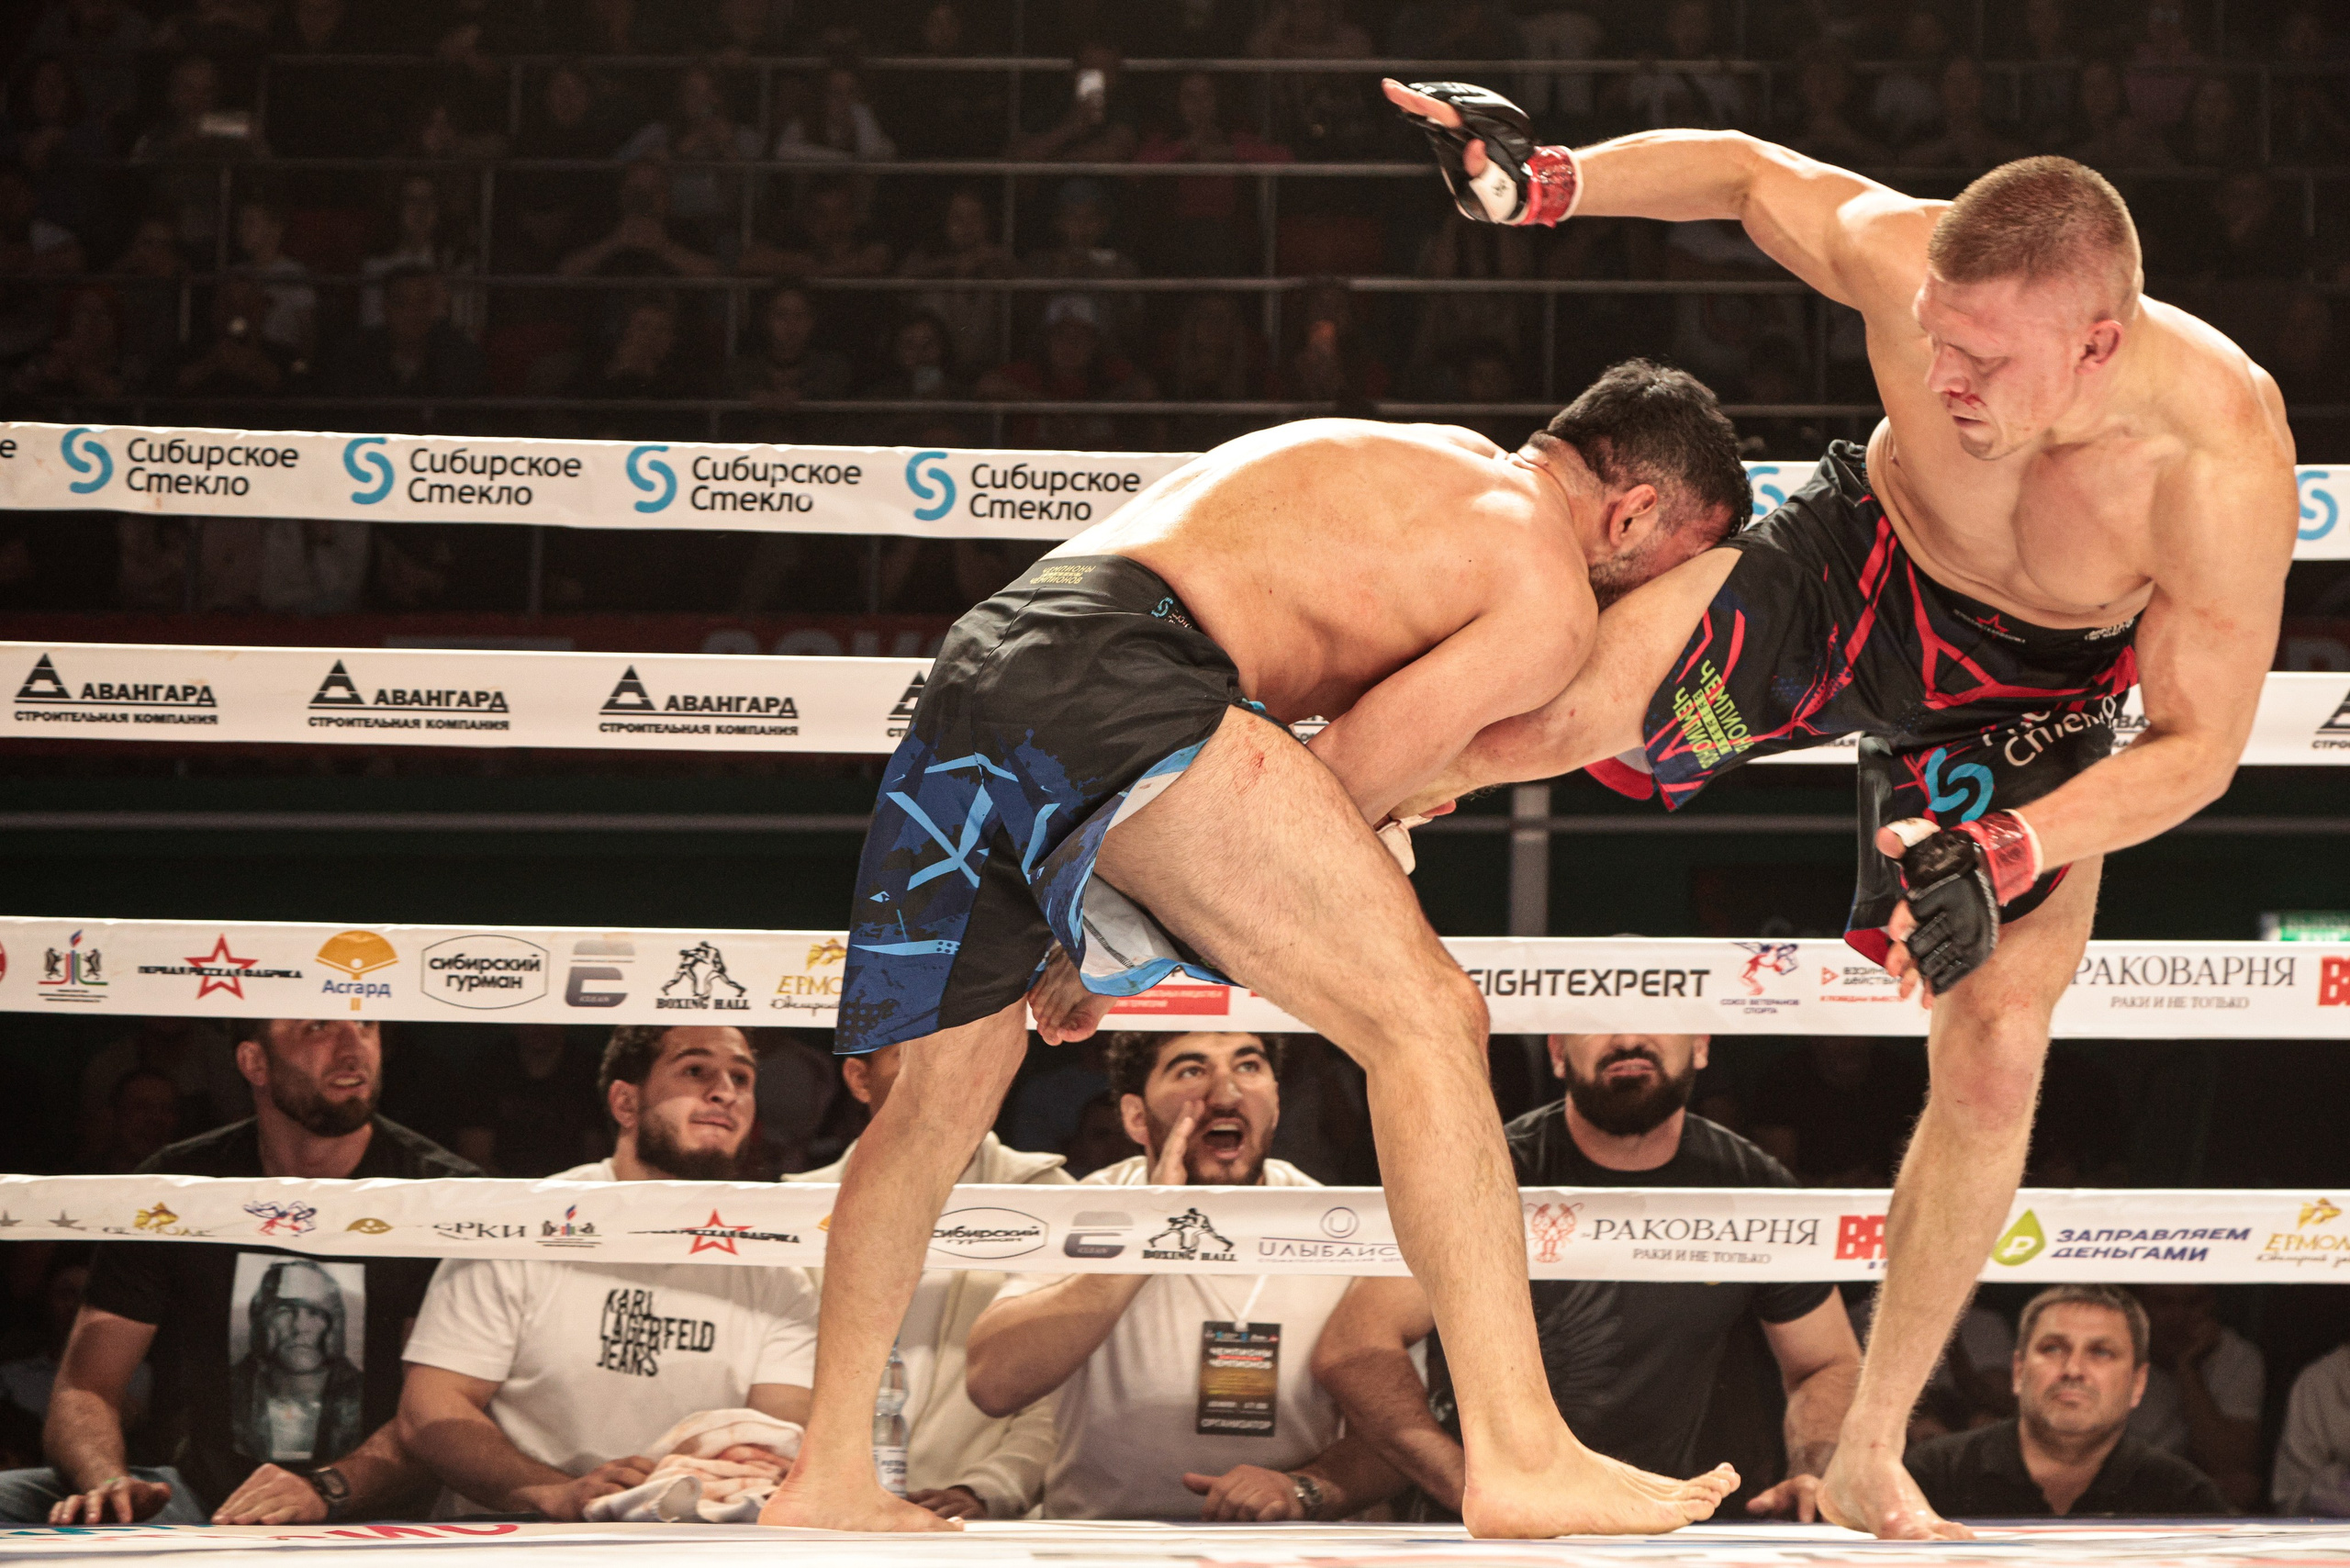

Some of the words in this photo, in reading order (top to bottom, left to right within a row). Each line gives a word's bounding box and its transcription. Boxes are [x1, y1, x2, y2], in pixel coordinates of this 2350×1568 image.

[127, 436, 300, 470] Сибирское
[409, 447, 582, 479] Сибирское
[691, 454, 862, 487] Сибирское
[970, 463, 1141, 496] Сибирское
[126, 466, 250, 497] Стекло
[408, 476, 532, 507] Стекло
[690, 485, 813, 514] Стекло
[969, 492, 1091, 521] Стекло
[80, 682, 217, 703] АВАНГАРД
[373, 689, 509, 710] АВАНГАРД
[664, 694, 799, 715] АВАНГАРД
[14, 711, 129, 723] СТРОИТЕЛЬНАЯ
[133, 712, 218, 726] КОМПАНИЯ
[308, 716, 420, 730] СТРОИТЕЛЬНАЯ
[425, 718, 510, 732] КОМПАНИЯ
[599, 722, 711, 735] СТРОИТЕЛЬНАЯ
[715, 723, 799, 737] КОМПАНИЯ
[428, 952, 542, 974] сибирский
[2071, 955, 2296, 988] РАКОВАРНЯ
[321, 978, 392, 999] Асгард
[445, 973, 523, 992] гурман
[655, 997, 710, 1010] BOXING
[713, 998, 751, 1010] HALL
[2110, 995, 2151, 1009] РАКИ
[2153, 996, 2165, 1009] И
[2166, 996, 2188, 1009] НЕ
[2190, 995, 2250, 1010] ТОЛЬКО
[933, 1226, 1040, 1238] сибирский
[1593, 1217, 1820, 1247] РАКОВАРНЯ
[2055, 1227, 2252, 1244] ЗАПРАВЛЯЕМ
[2264, 1233, 2350, 1250] ЕРМОЛ
[1142, 1249, 1197, 1262] BOXING
[1200, 1249, 1237, 1262] HALL
[1633, 1248, 1673, 1261] РАКИ
[1674, 1249, 1687, 1261] И
[1689, 1249, 1710, 1262] НЕ
[1712, 1250, 1772, 1264] ТОЛЬКО
[2051, 1246, 2210, 1263] ДЕНЬГАМИ
[603, 1288, 654, 1315] KARL
[599, 1307, 716, 1356] LAGERFELD
[596, 1337, 659, 1377] JEANS
